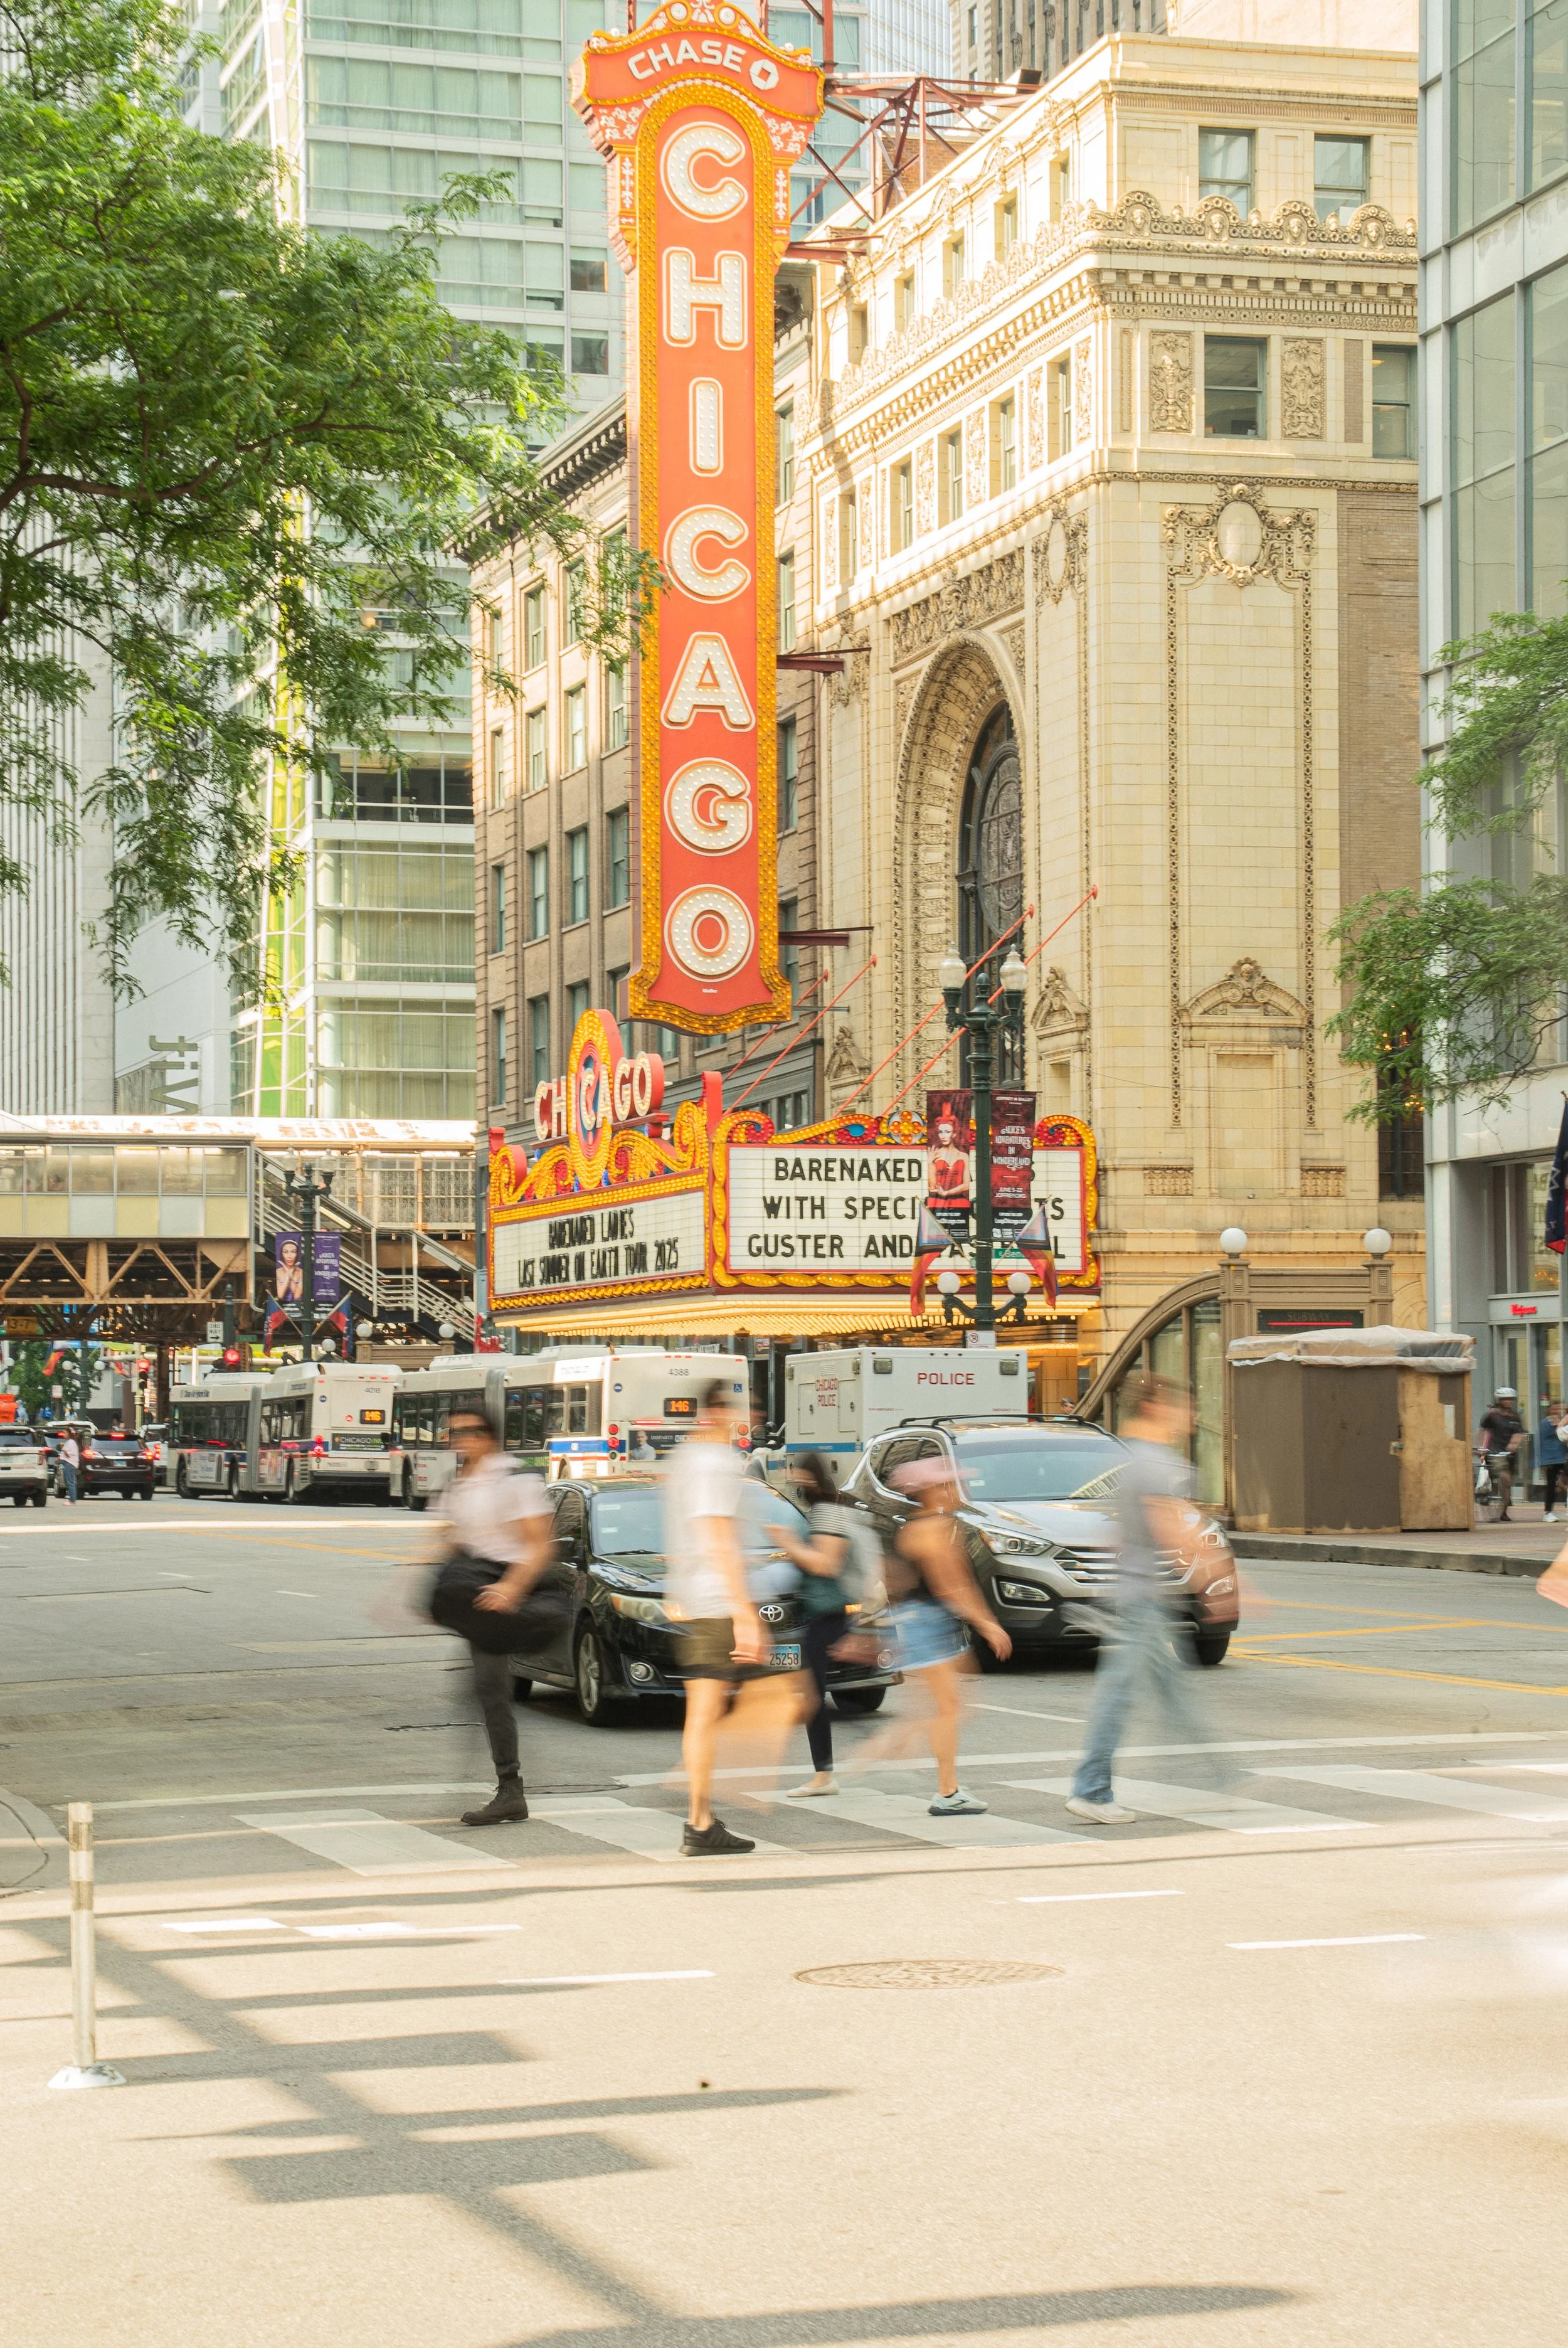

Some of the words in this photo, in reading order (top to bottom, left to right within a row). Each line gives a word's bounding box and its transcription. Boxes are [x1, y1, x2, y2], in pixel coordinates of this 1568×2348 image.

[628, 39, 748, 80] CHASE
[660, 120, 756, 984] CHICAGO
[534, 1051, 653, 1141] CHICAGO
[775, 1157, 922, 1182] BARENAKED
[763, 1196, 825, 1219] WITH
[845, 1196, 915, 1220] SPECI
[748, 1233, 844, 1258] GUSTER
[864, 1233, 914, 1258] AND
[1287, 1312, 1330, 1322] SUBWAY
[668, 1368, 690, 1376] 4388
[815, 1378, 839, 1391] CHICAGO
[917, 1373, 975, 1385] POLICE
[670, 1400, 690, 1412] 146
[818, 1394, 837, 1407] POLICE
[770, 1652, 799, 1665] 25258
